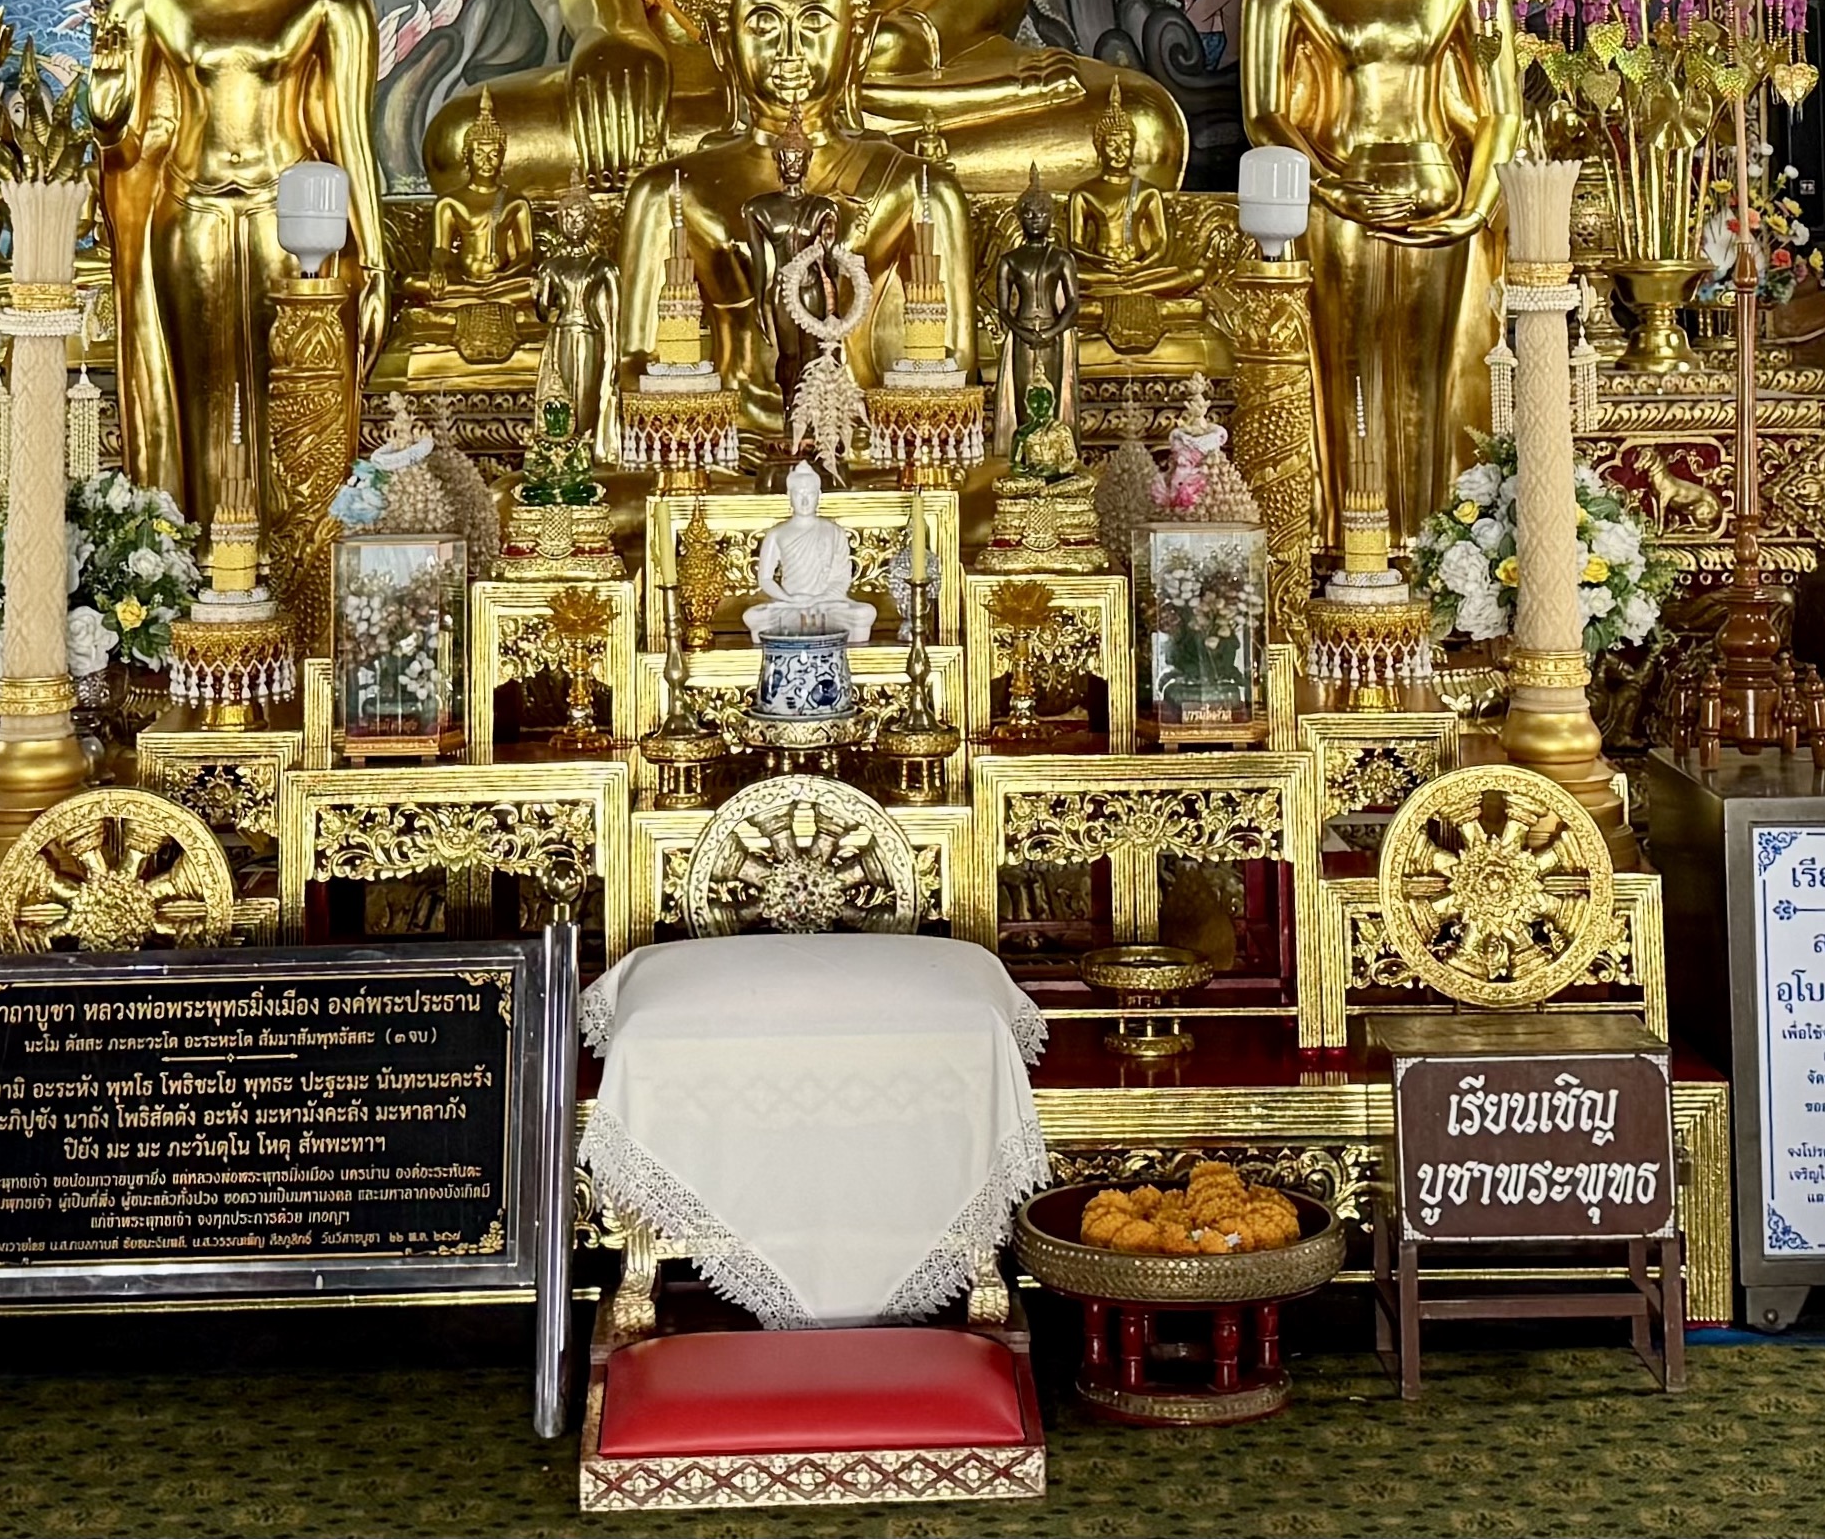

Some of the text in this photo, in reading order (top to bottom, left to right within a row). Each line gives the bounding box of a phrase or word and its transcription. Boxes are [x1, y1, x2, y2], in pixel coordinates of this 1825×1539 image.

[83, 985, 320, 1027] หลวงพ่อพระพุทธมิ่งเมือง
[328, 985, 481, 1015] องค์พระประธาน
[23, 1032, 60, 1053] นะโม
[32, 1073, 99, 1099] อะระหัง
[105, 1071, 154, 1104] พุทโธ
[158, 1069, 237, 1096] โพธิชะโย
[243, 1076, 294, 1101] พุทธะ
[299, 1070, 370, 1099] ปะฐะมะ
[375, 1066, 492, 1094] นันทะนะคะรัง
[63, 1104, 110, 1130] นาถัง
[115, 1102, 197, 1129] โพธิสัตตัง
[203, 1100, 249, 1127] อะหัง
[254, 1097, 369, 1125] มะหามังคะลัง
[375, 1095, 467, 1122] มะหาลาภัง
[1446, 1072, 1620, 1147] เรียนเชิญ
[106, 1142, 131, 1160] มะ
[136, 1141, 161, 1159] มะ
[166, 1131, 251, 1164] ภะวันตุโน
[256, 1130, 291, 1162] โหตุ
[298, 1129, 386, 1155] สัพพะทาฯ
[1416, 1159, 1661, 1226] บูชาพระพุทธ
